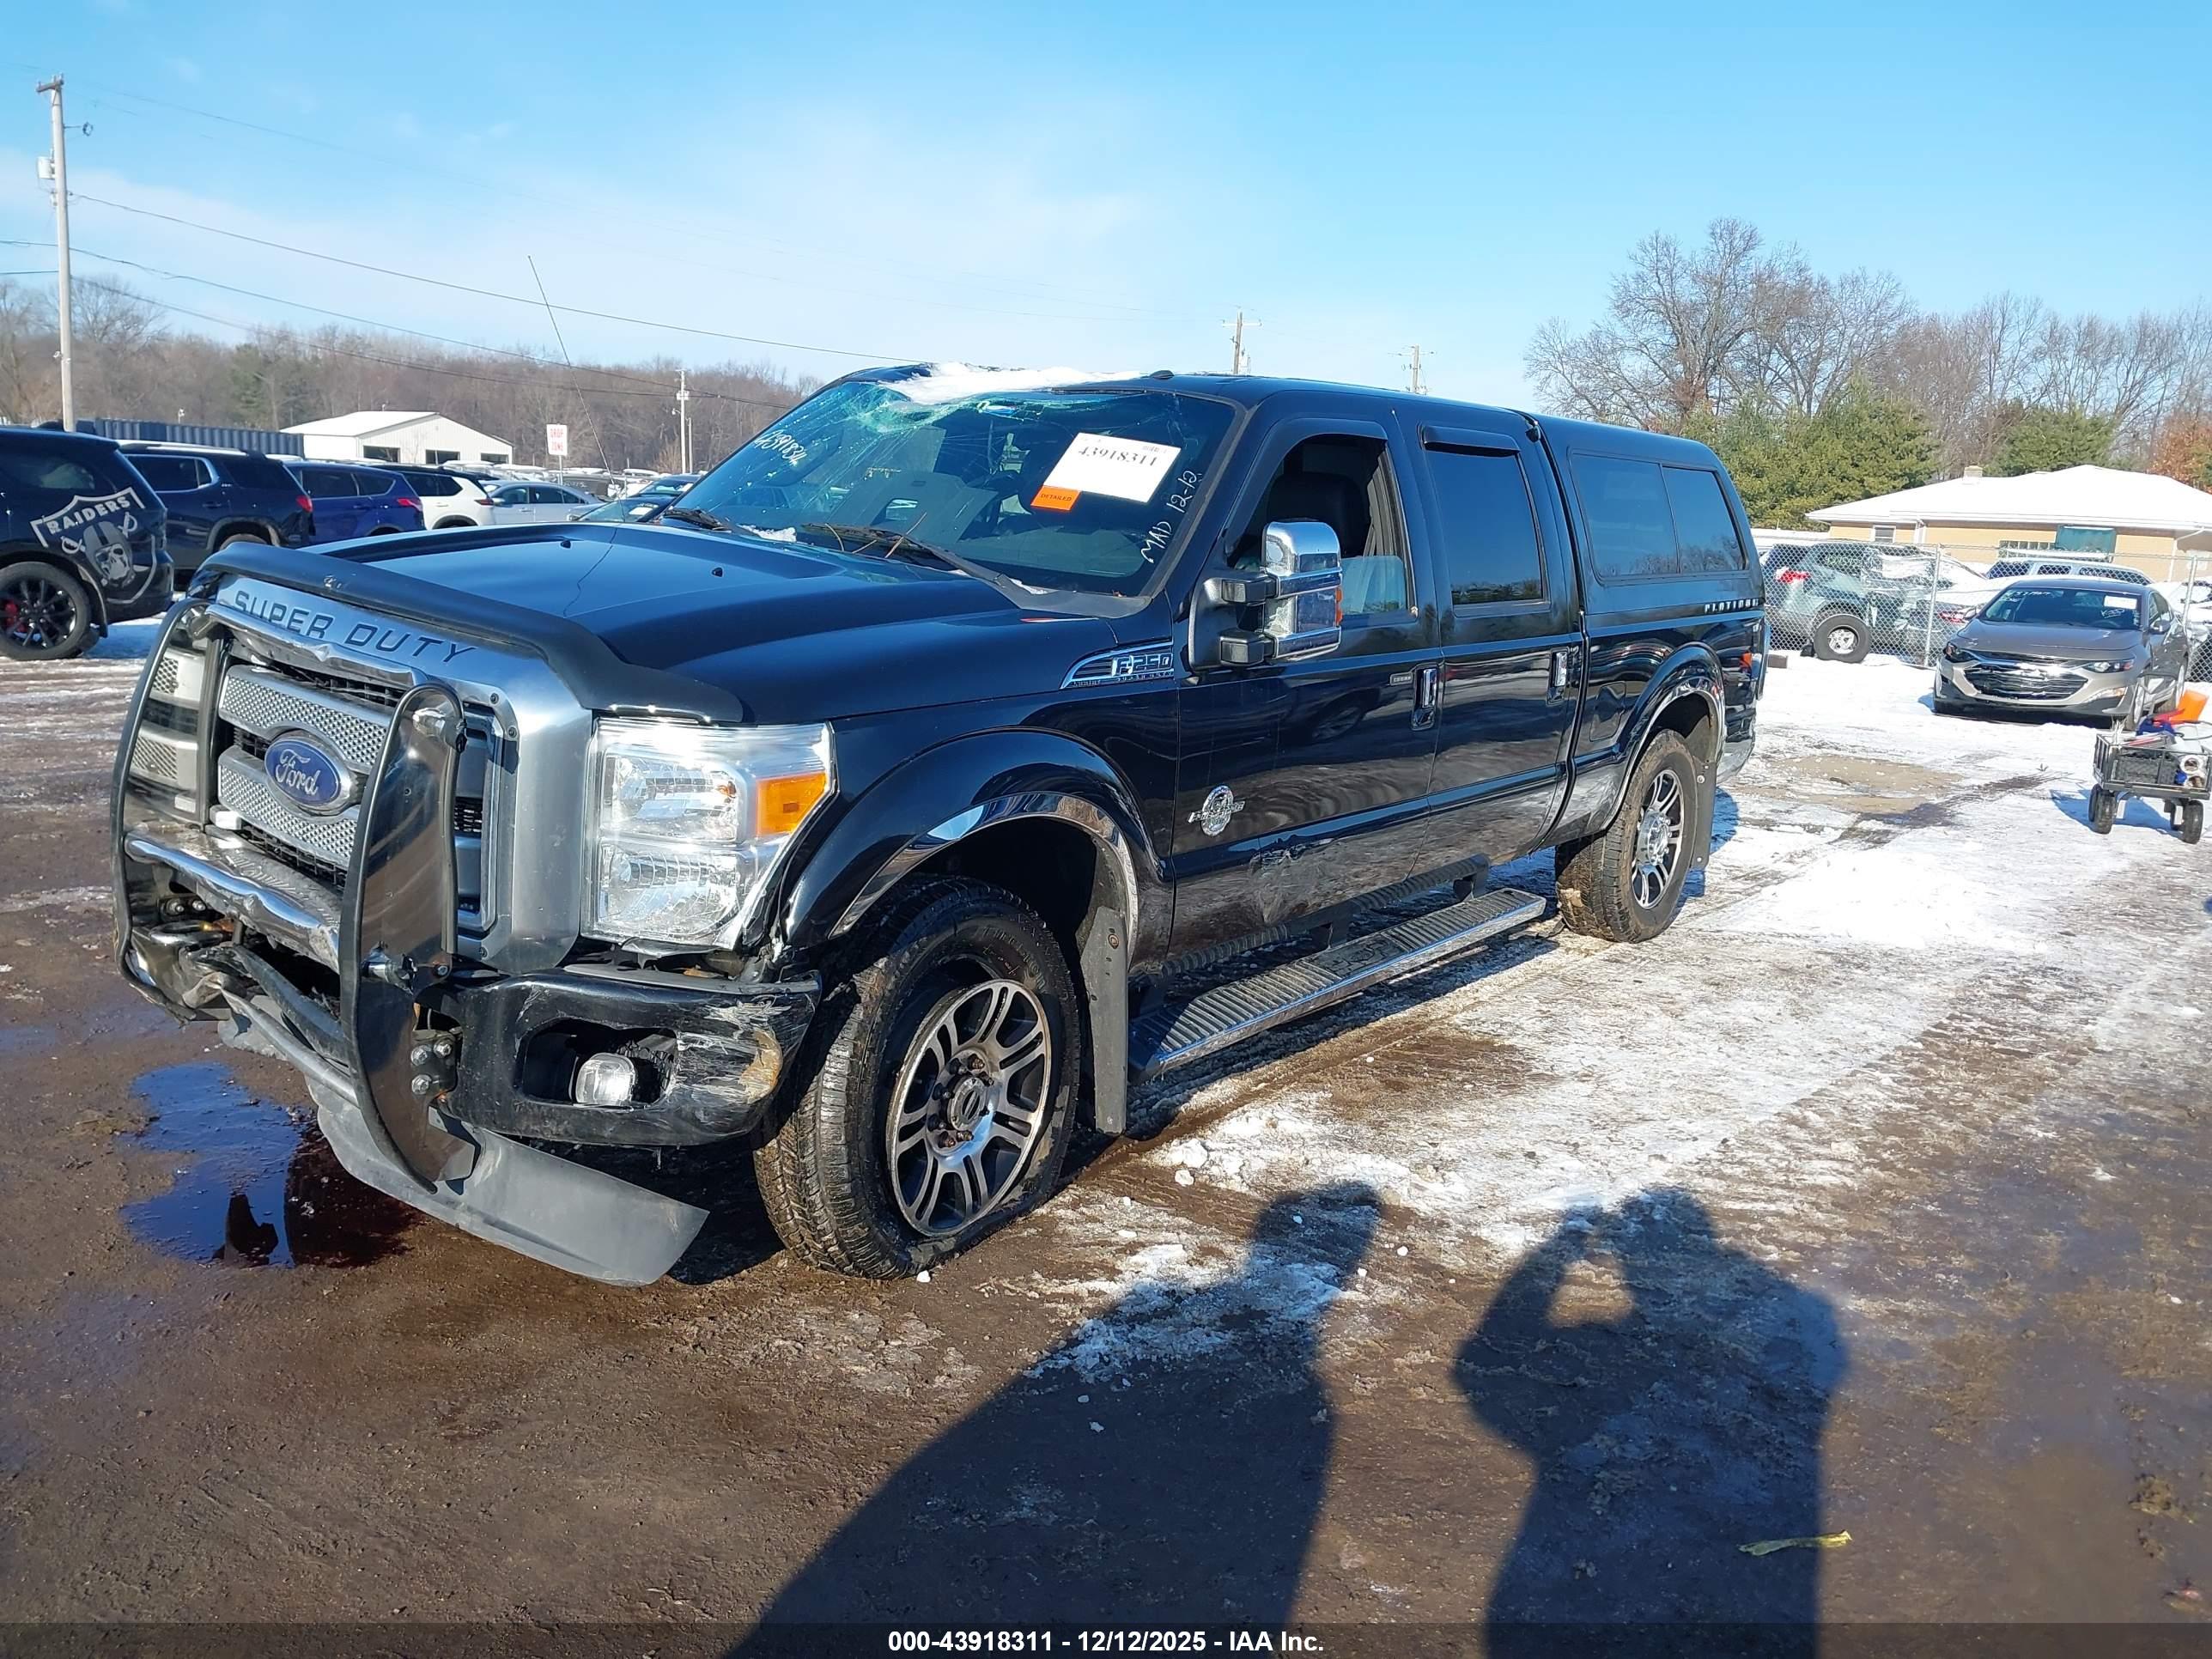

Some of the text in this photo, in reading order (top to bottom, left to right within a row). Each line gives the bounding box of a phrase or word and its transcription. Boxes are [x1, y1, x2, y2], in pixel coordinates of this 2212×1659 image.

[1078, 445, 1158, 466] 43918311
[46, 496, 131, 534] RAIDERS
[1040, 493, 1073, 501] DETAILED
[1140, 521, 1173, 564] MAD
[234, 590, 476, 663] SUPER DUTY
[275, 749, 321, 795] Ford
